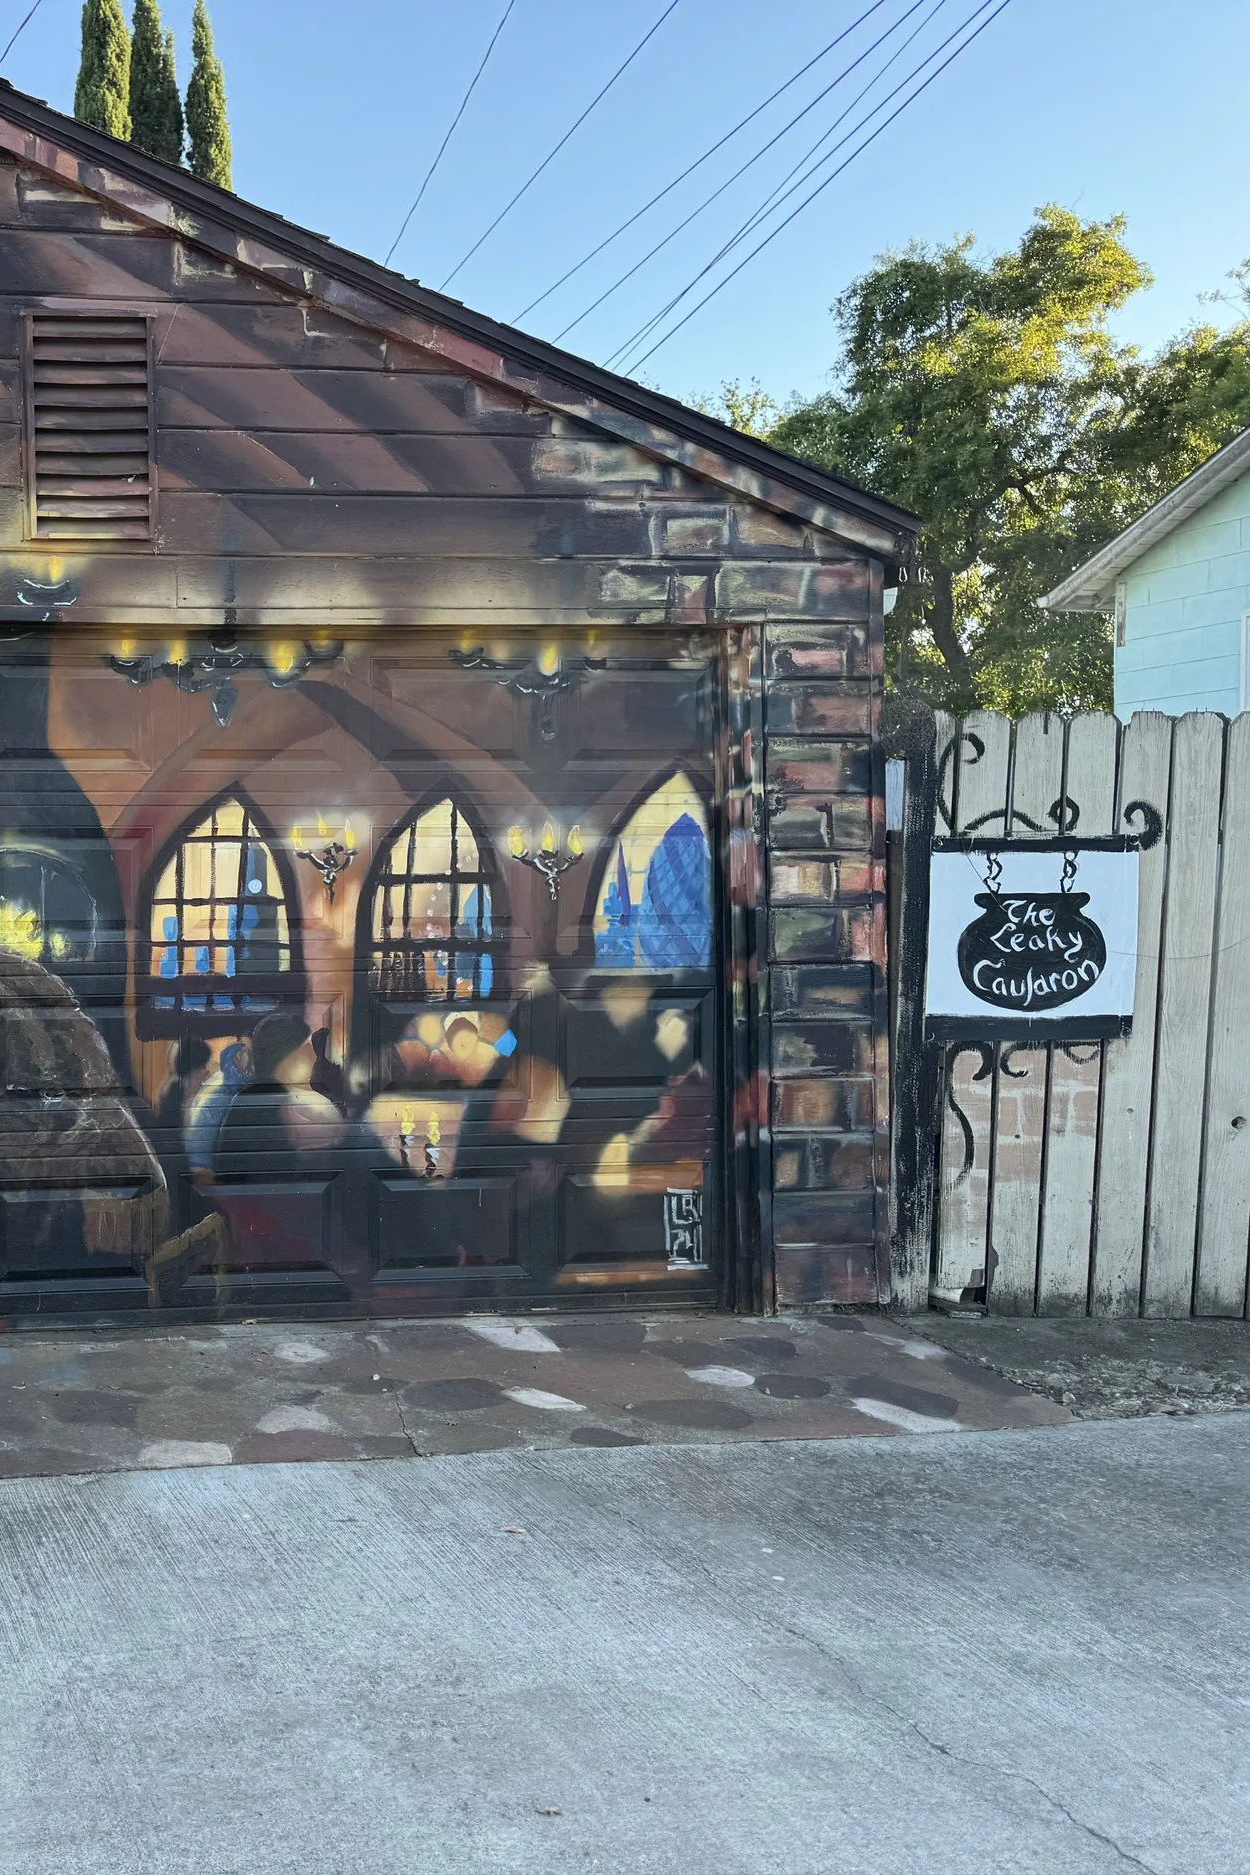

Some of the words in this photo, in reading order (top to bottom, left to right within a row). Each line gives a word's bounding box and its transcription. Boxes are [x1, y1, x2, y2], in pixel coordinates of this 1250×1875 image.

[1003, 900, 1056, 926] The
[990, 923, 1083, 963] Leaky
[973, 959, 1100, 1006] Cauldron
